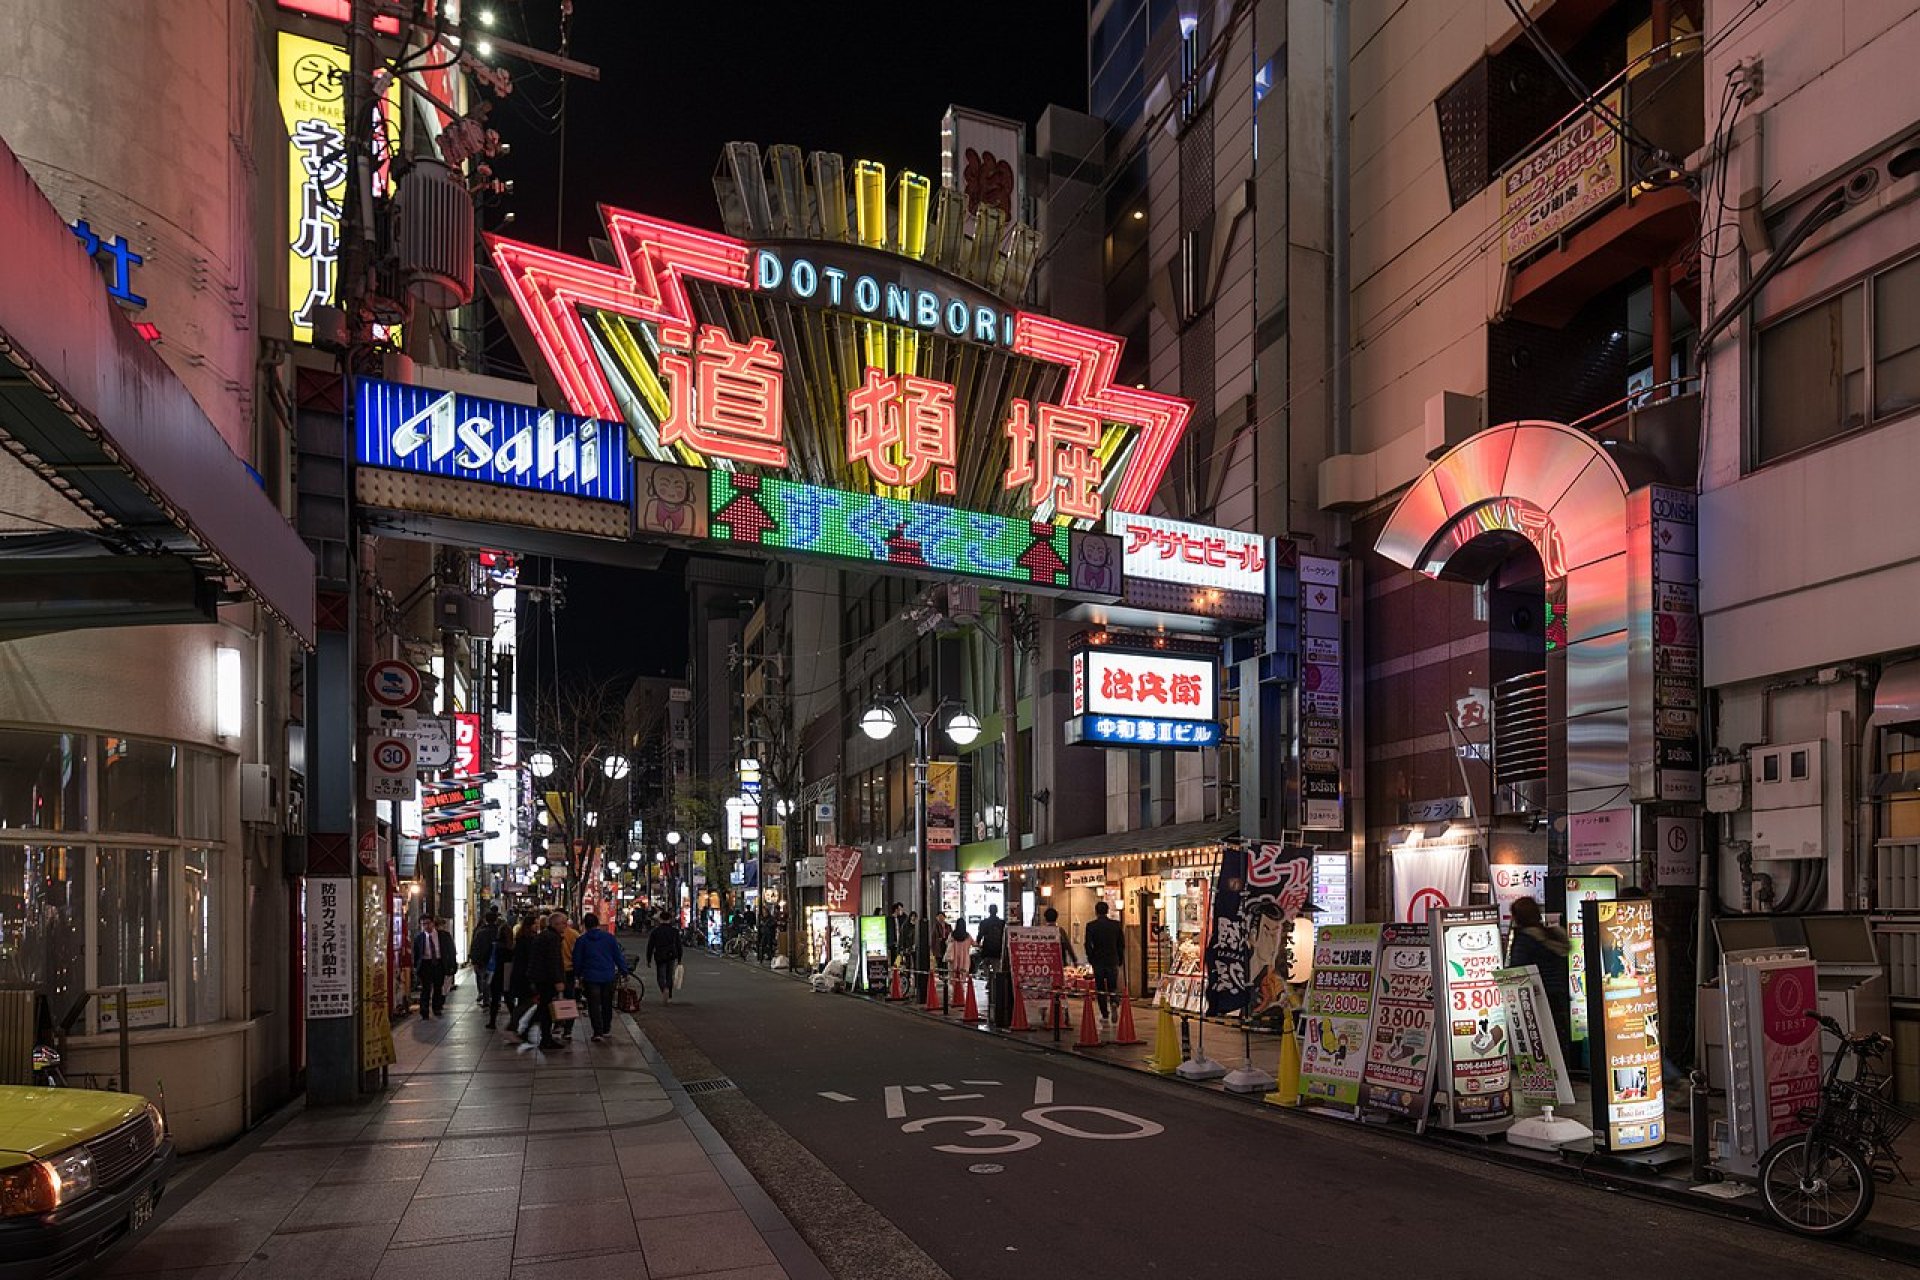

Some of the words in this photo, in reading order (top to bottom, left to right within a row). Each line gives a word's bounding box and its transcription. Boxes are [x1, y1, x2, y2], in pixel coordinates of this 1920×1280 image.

[294, 100, 315, 112] NET
[757, 249, 1015, 346] DOTONBORI
[392, 391, 598, 485] Asahi
[659, 325, 1102, 520] 道頓堀
[779, 486, 1015, 571] すぐそこ
[1126, 525, 1266, 572] アサヒビール
[1101, 667, 1202, 706] 治兵衛
[382, 748, 403, 764] 30
[455, 719, 474, 779] カラ
[374, 786, 410, 795] ここから
[1247, 844, 1312, 887] ビール
[321, 882, 337, 978] 防犯カメラ作動中
[1600, 904, 1614, 916] 7F
[1316, 971, 1369, 987] 全身もみほぐし
[1323, 993, 1368, 1013] 2,800円
[1775, 1018, 1808, 1033] FIRST
[901, 1105, 1165, 1154] 30
